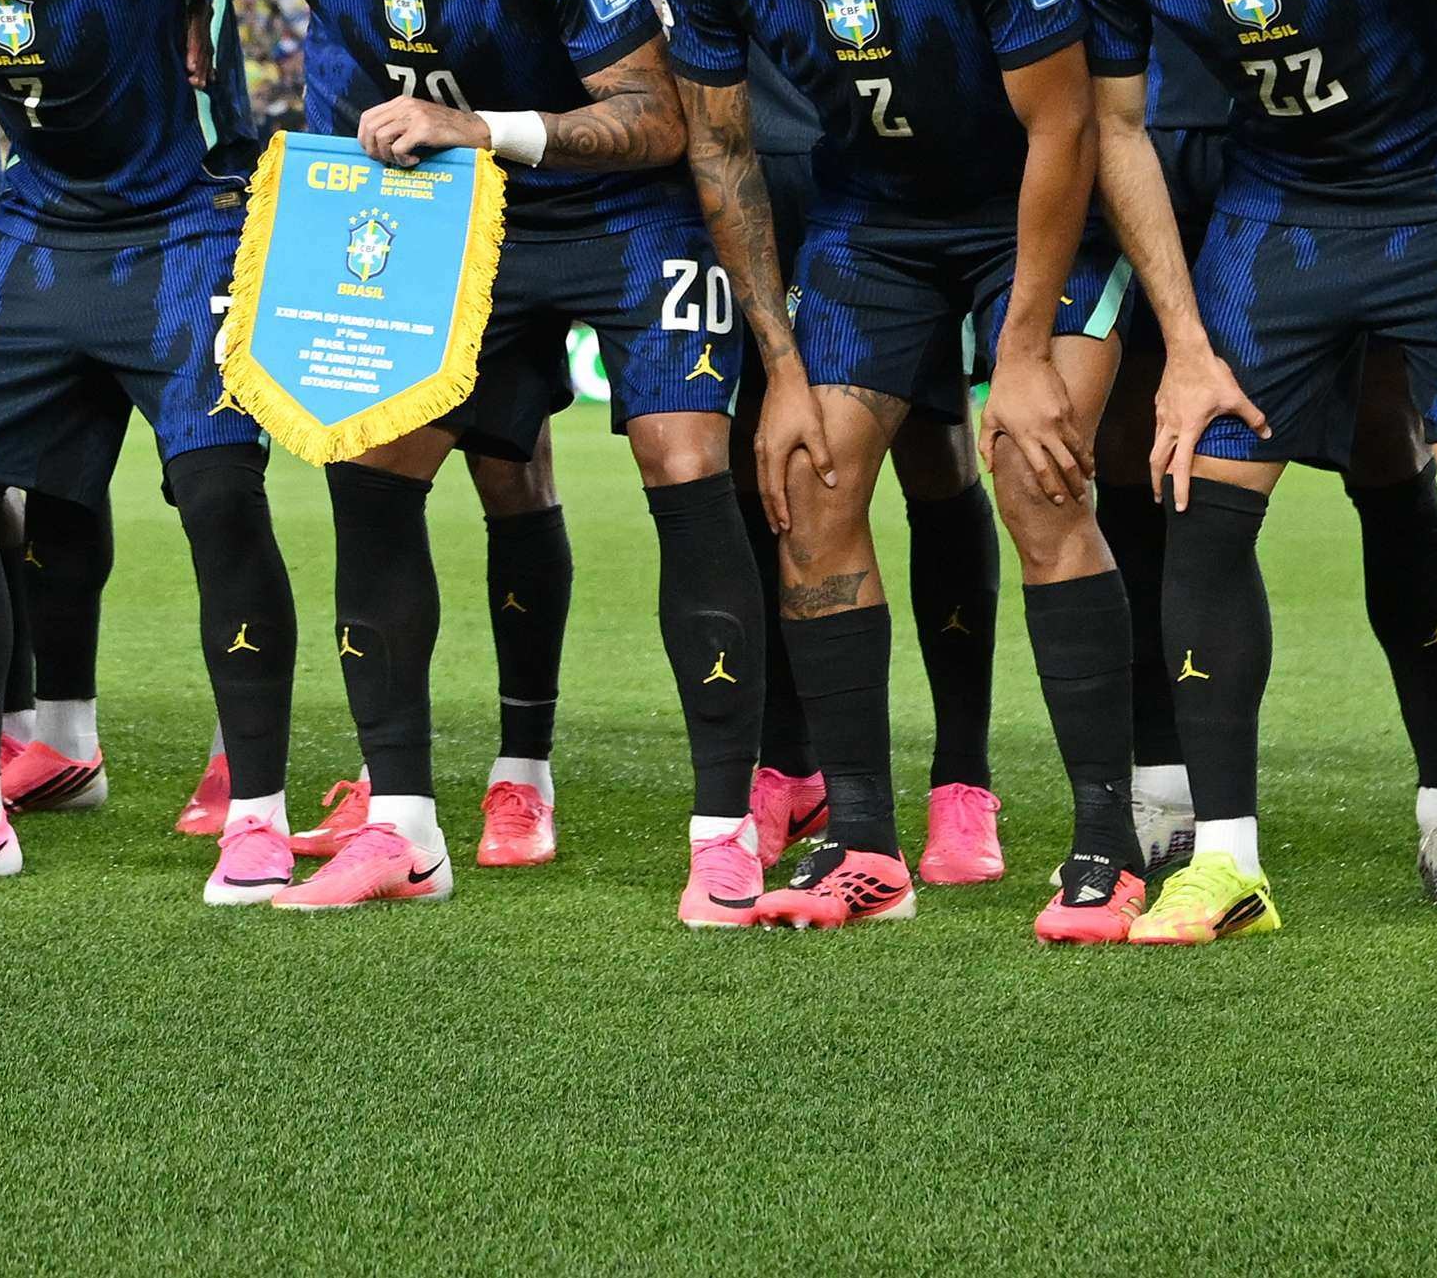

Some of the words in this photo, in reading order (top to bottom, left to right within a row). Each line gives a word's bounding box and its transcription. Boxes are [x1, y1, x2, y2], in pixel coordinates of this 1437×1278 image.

[840, 6, 860, 16] CBF
[1238, 24, 1299, 45] BRASIL
[389, 38, 438, 54] BRASIL
[836, 46, 892, 61] BRASIL
[1241, 47, 1349, 116] 22
[8, 77, 43, 128] 7
[854, 77, 914, 137] 2
[307, 161, 371, 193] CBF
[394, 188, 435, 200] FUTEBOL
[337, 282, 385, 300] BRASIL
[661, 258, 734, 335] 20
[358, 344, 386, 356] HAITI
[309, 363, 377, 381] PHILADELPHIA
